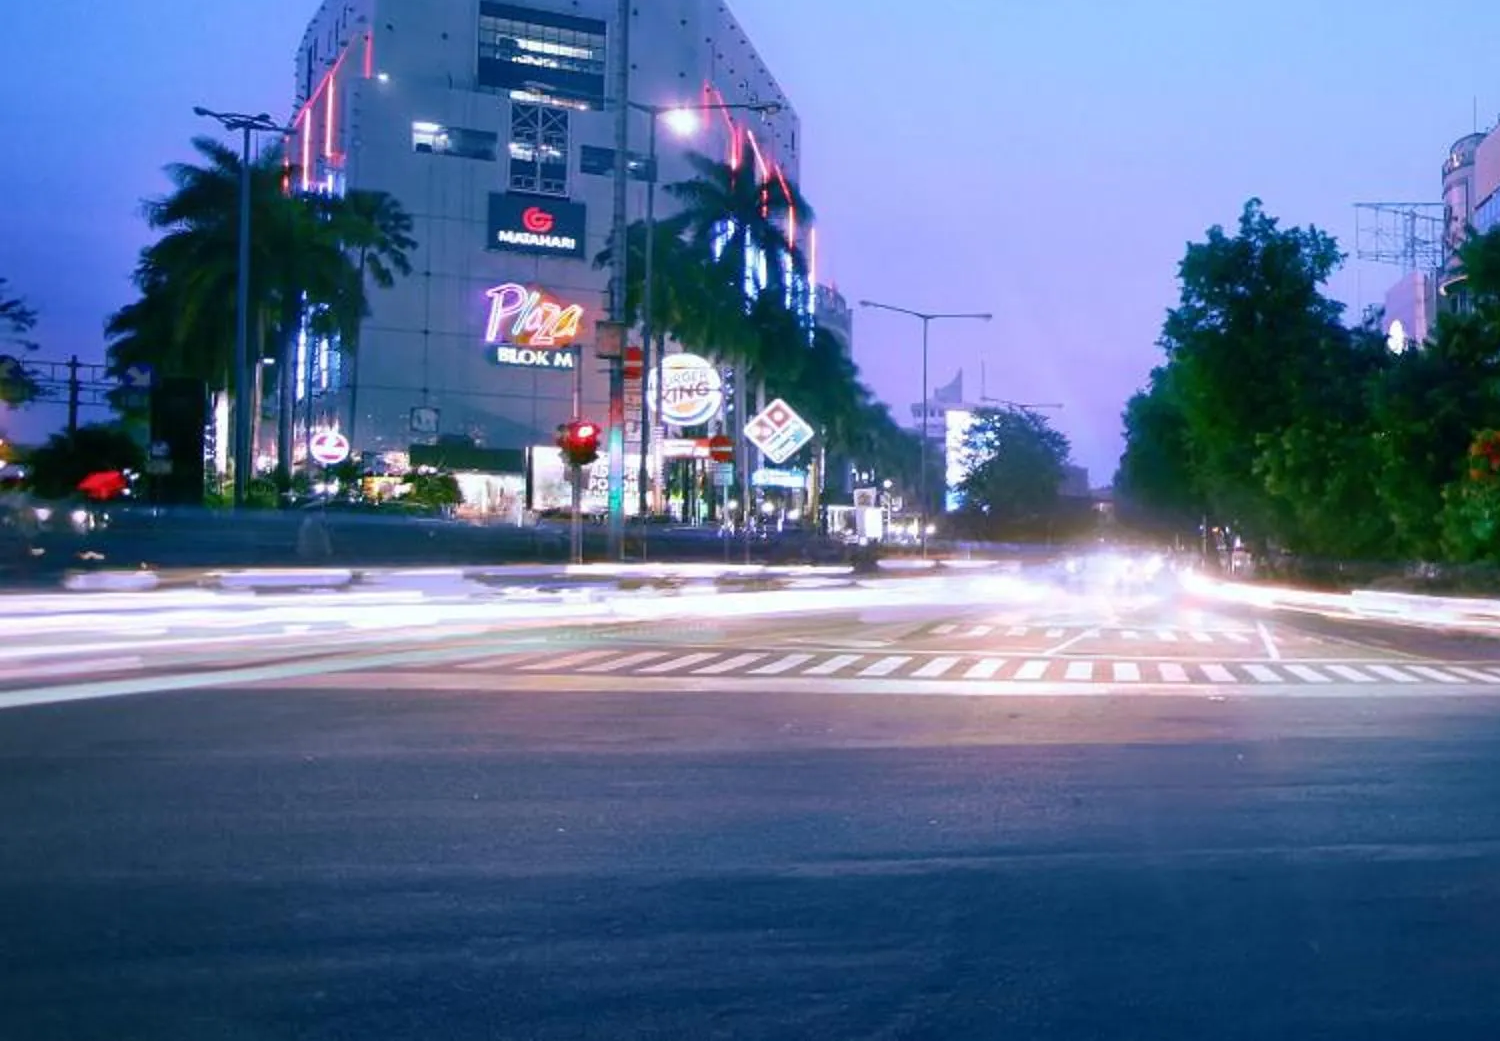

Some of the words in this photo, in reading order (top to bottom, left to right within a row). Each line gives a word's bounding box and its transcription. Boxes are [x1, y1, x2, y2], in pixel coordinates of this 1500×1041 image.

[498, 230, 576, 250] MATAHARI
[485, 282, 584, 346] Plaza
[497, 347, 550, 366] BLOK
[553, 351, 574, 368] M
[661, 370, 709, 386] URGER
